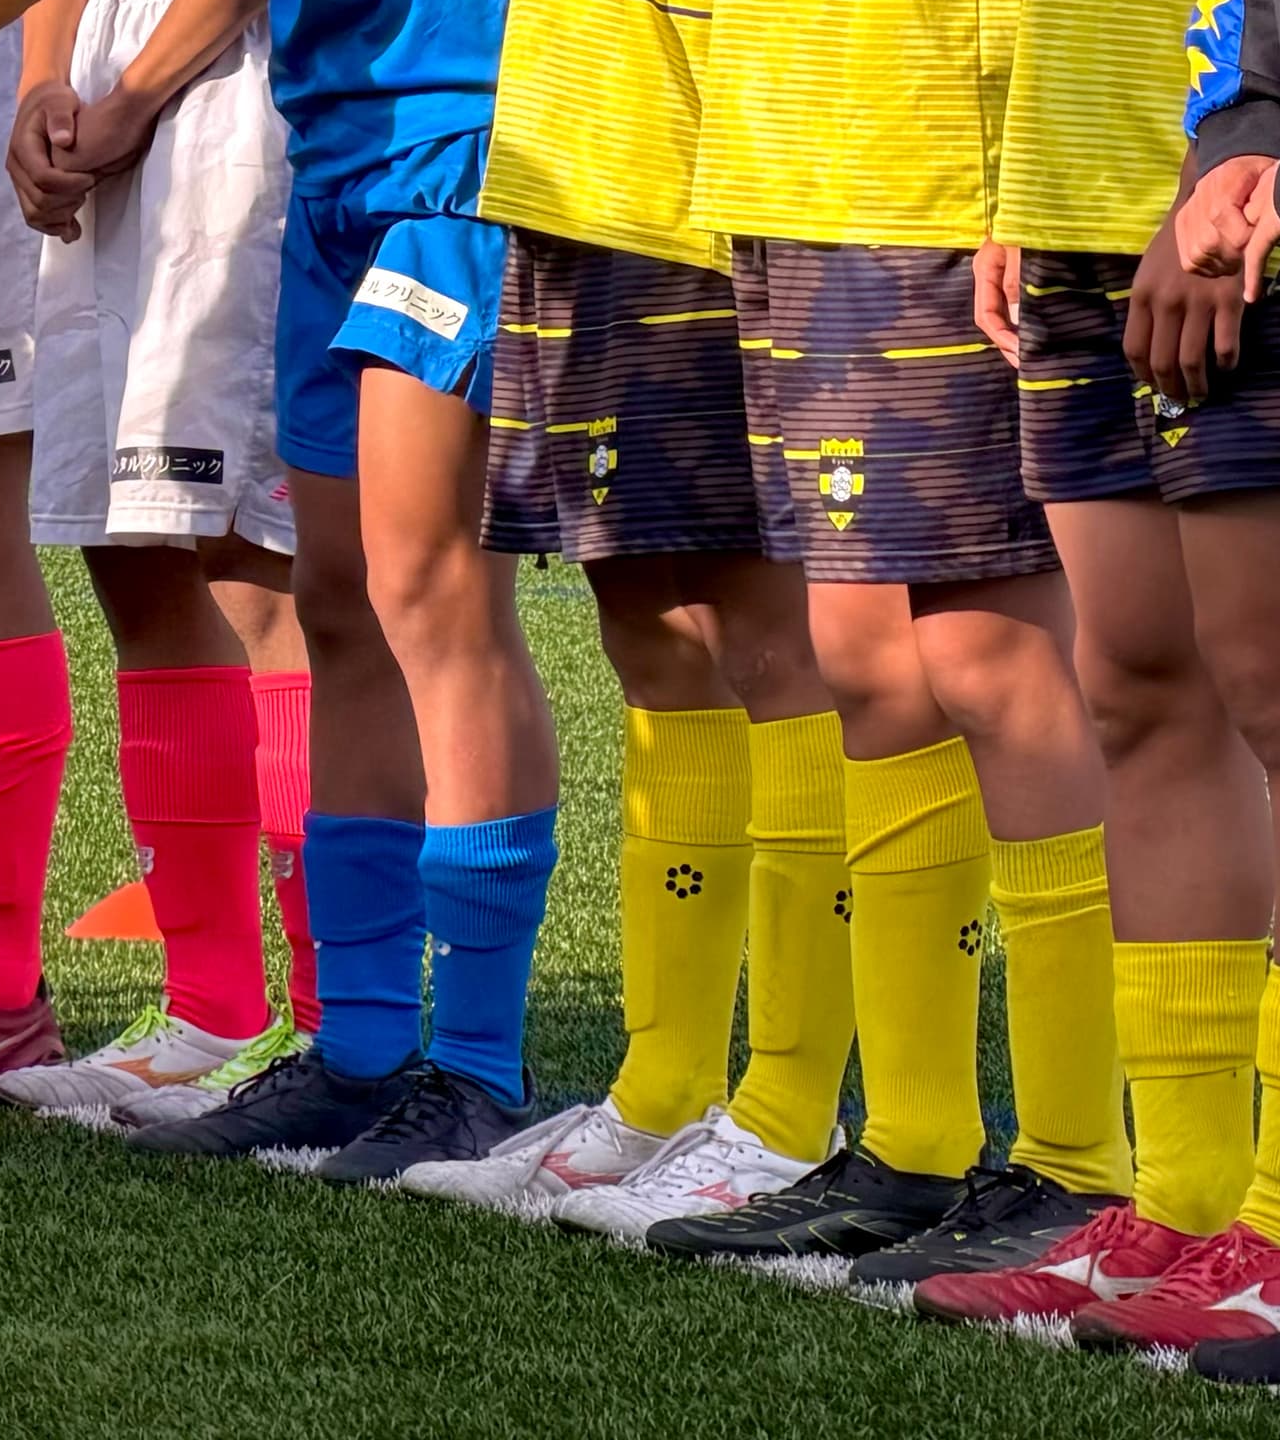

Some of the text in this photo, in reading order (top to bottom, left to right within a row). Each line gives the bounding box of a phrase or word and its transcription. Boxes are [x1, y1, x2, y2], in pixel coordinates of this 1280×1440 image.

[362, 279, 462, 327] ルクリニック
